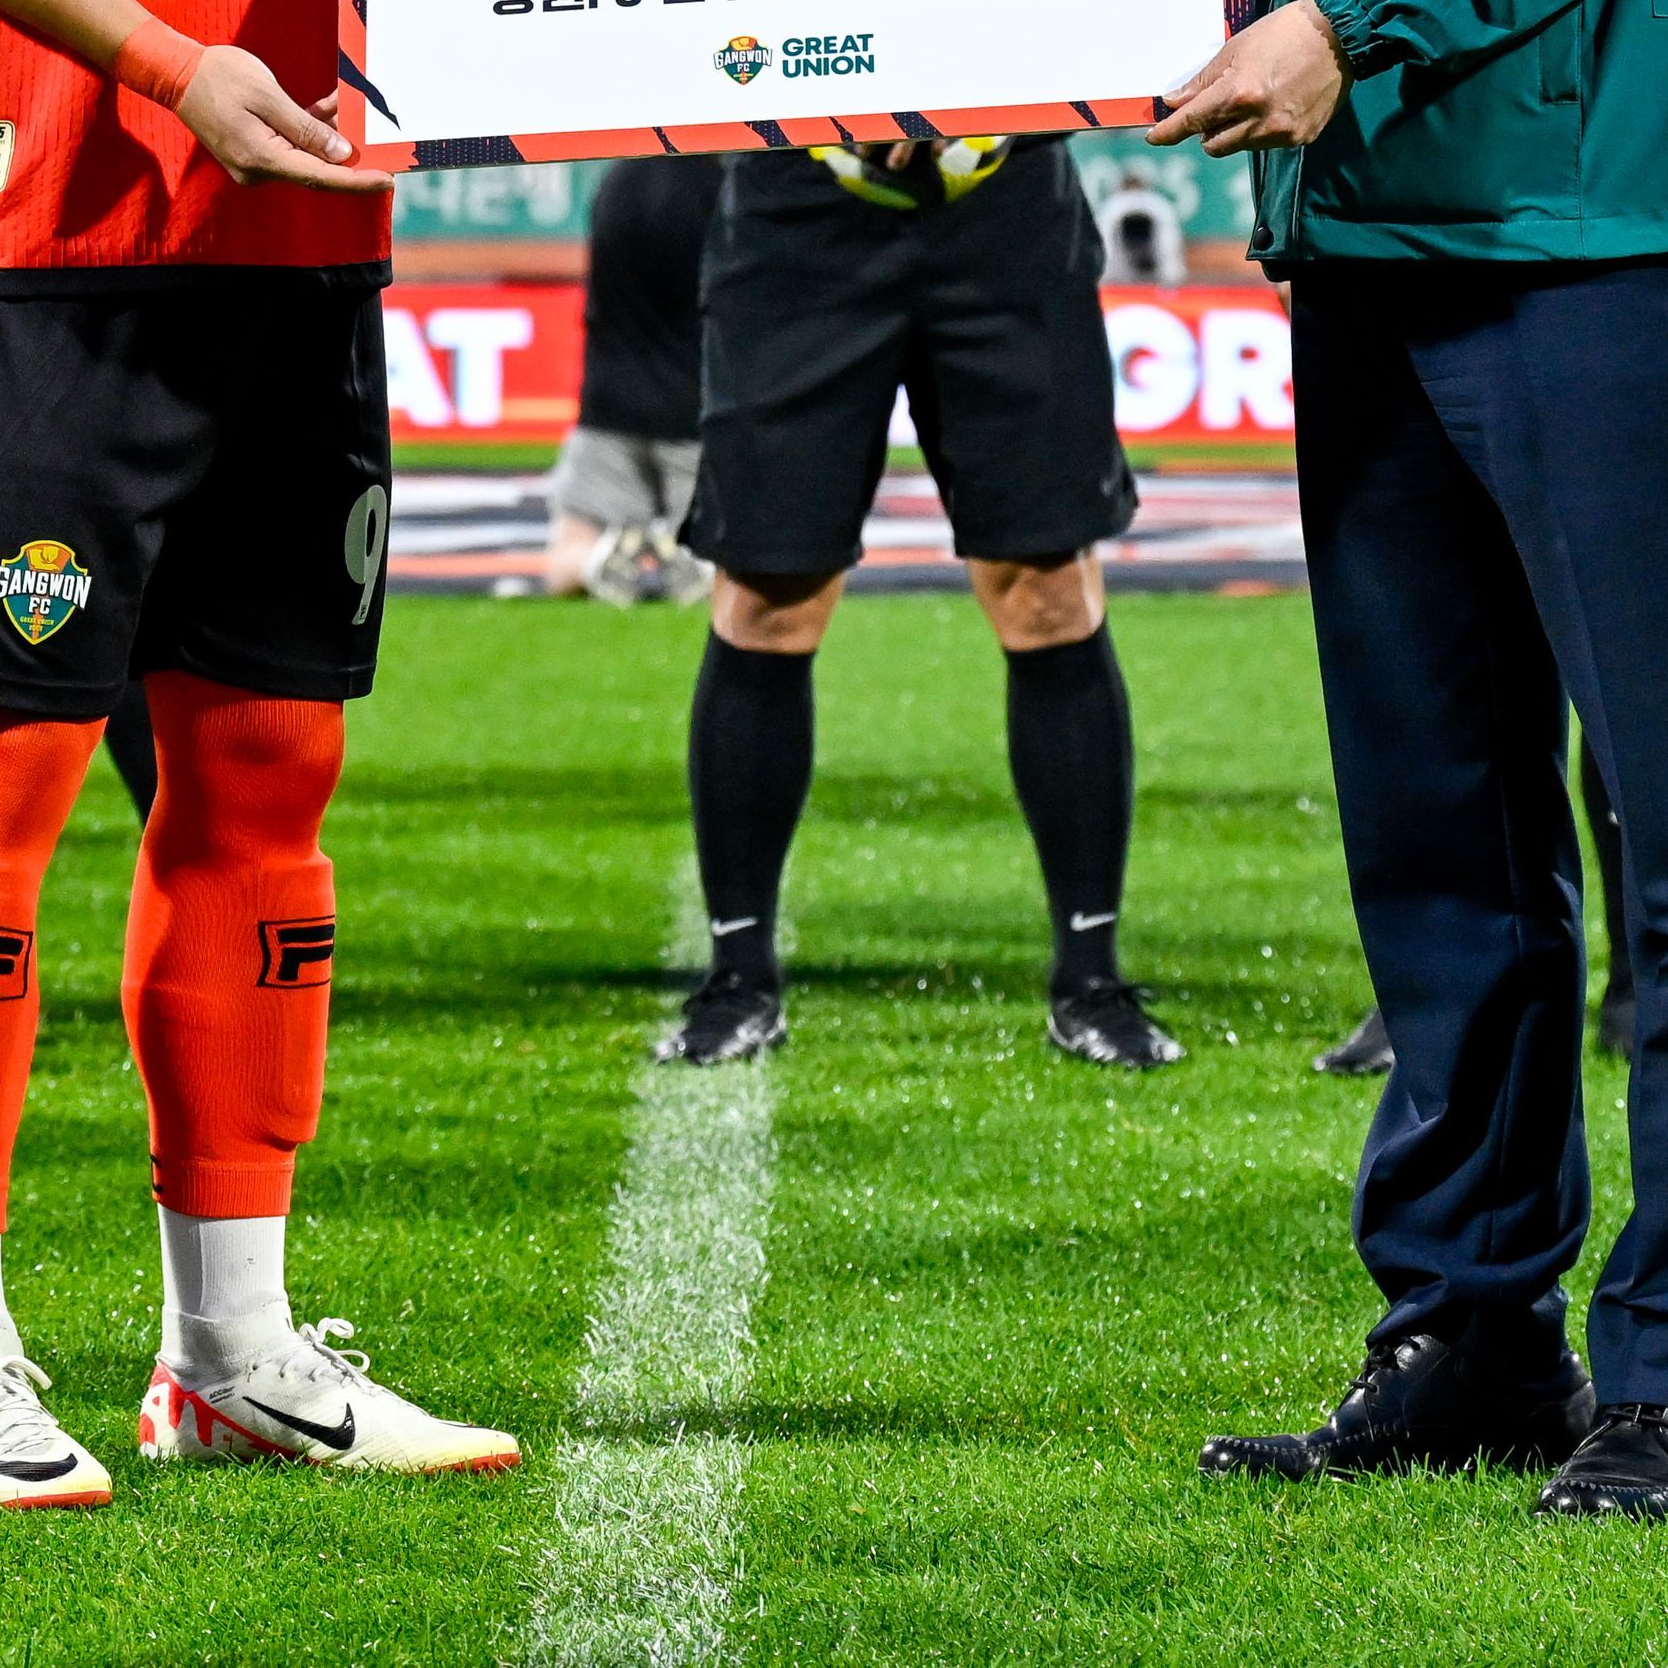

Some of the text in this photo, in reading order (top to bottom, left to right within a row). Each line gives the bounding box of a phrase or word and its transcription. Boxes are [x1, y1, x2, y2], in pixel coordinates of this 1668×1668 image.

[782, 33, 874, 57] GREAT
[713, 48, 773, 70] GANGWON
[736, 63, 750, 73] FC
[782, 54, 875, 78] UNION
[344, 484, 387, 625] 9
[28, 596, 51, 615] FC
